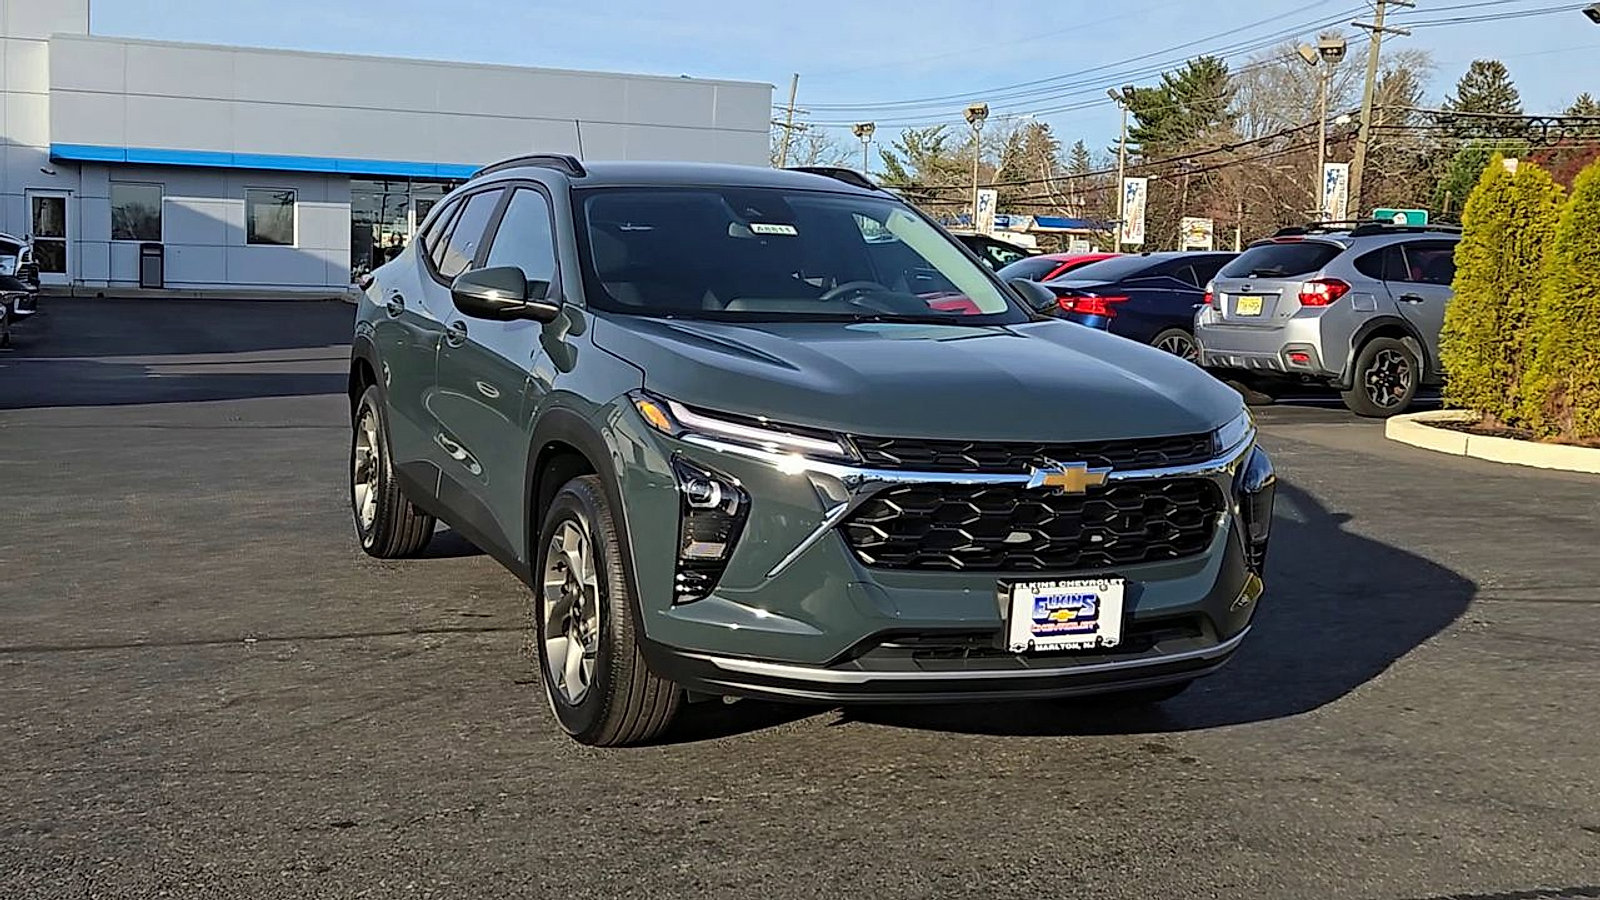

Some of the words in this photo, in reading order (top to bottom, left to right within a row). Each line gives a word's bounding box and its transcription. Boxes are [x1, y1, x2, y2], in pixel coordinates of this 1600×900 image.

[1015, 581, 1056, 589] ELKINS
[1059, 579, 1125, 588] CHEVROLET
[1032, 593, 1097, 619] ELKINS
[1083, 641, 1096, 649] NJ
